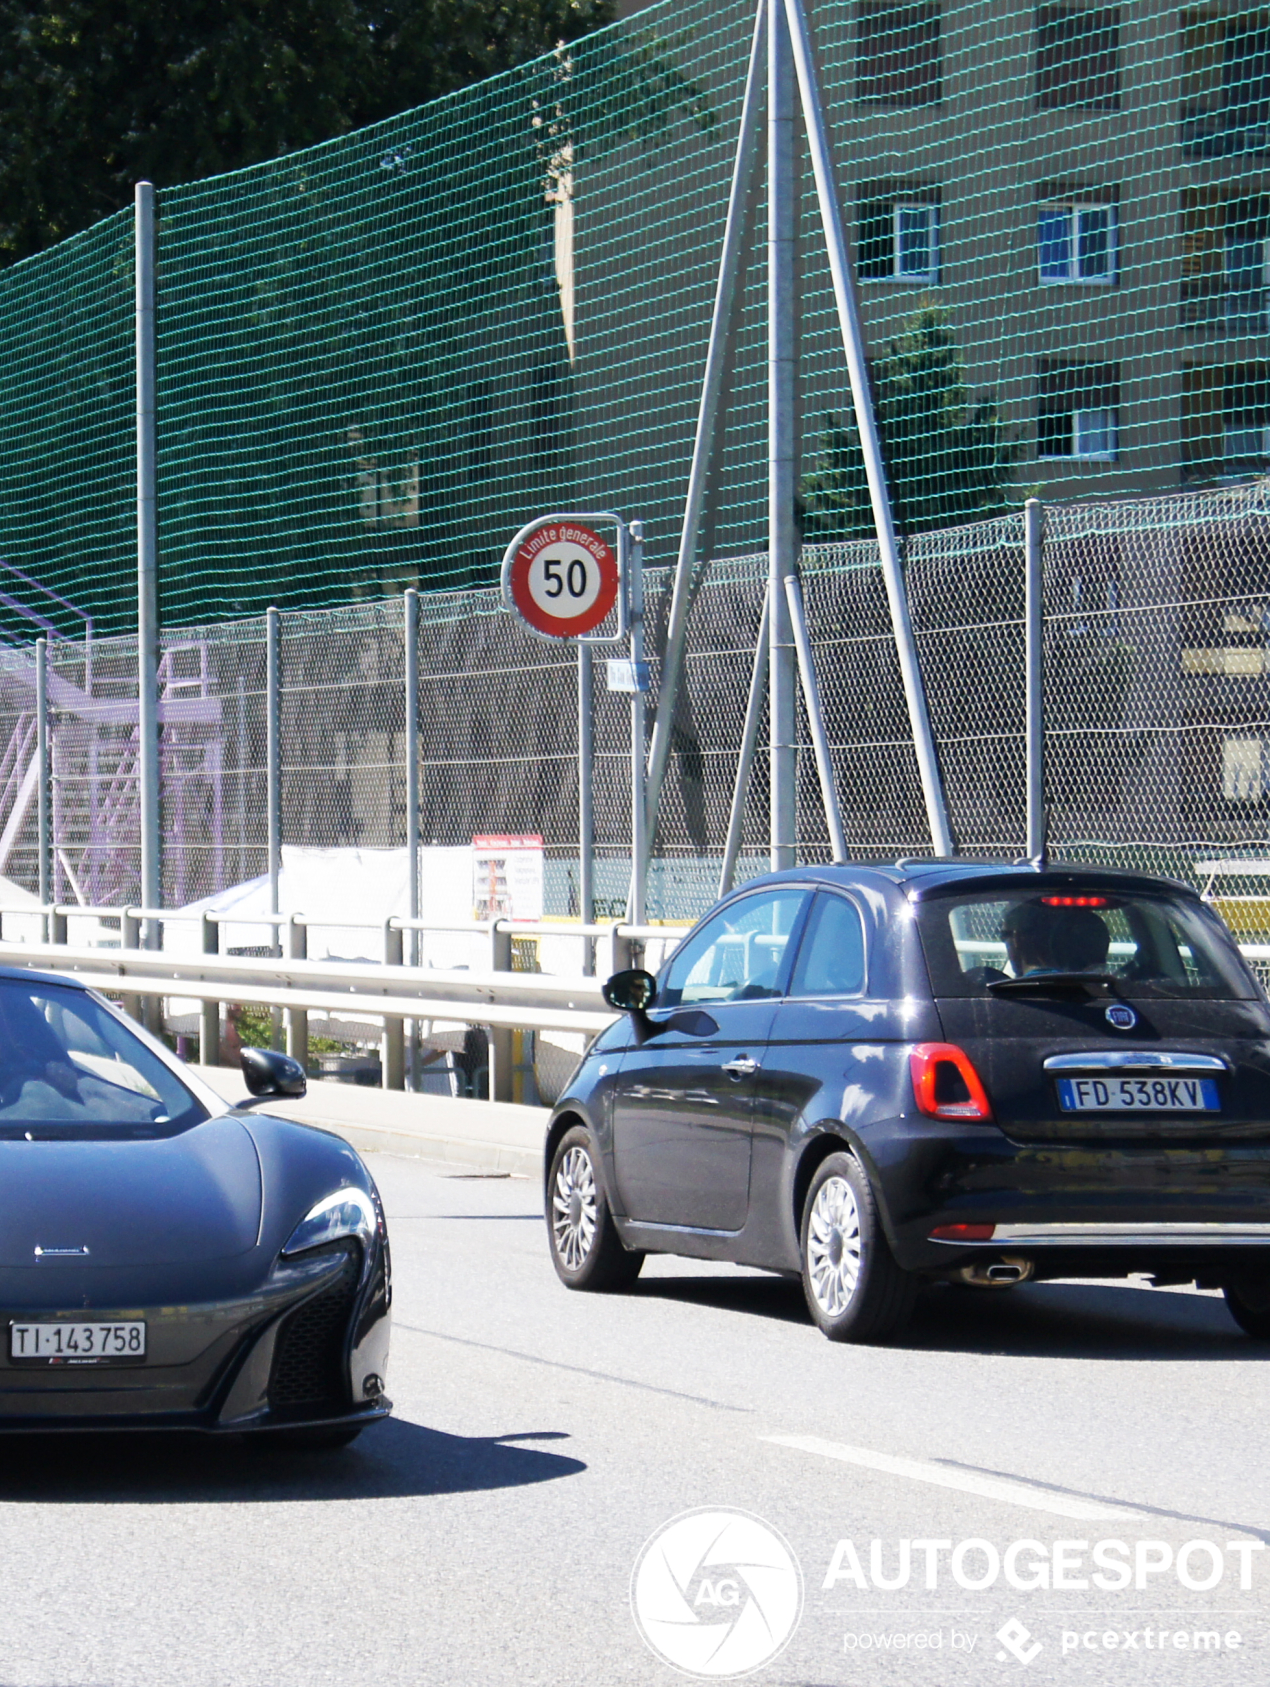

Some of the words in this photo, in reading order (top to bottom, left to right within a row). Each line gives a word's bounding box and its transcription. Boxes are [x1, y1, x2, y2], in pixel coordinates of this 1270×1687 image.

[519, 528, 557, 560] Limite
[559, 526, 607, 560] generale
[543, 559, 587, 598] 50
